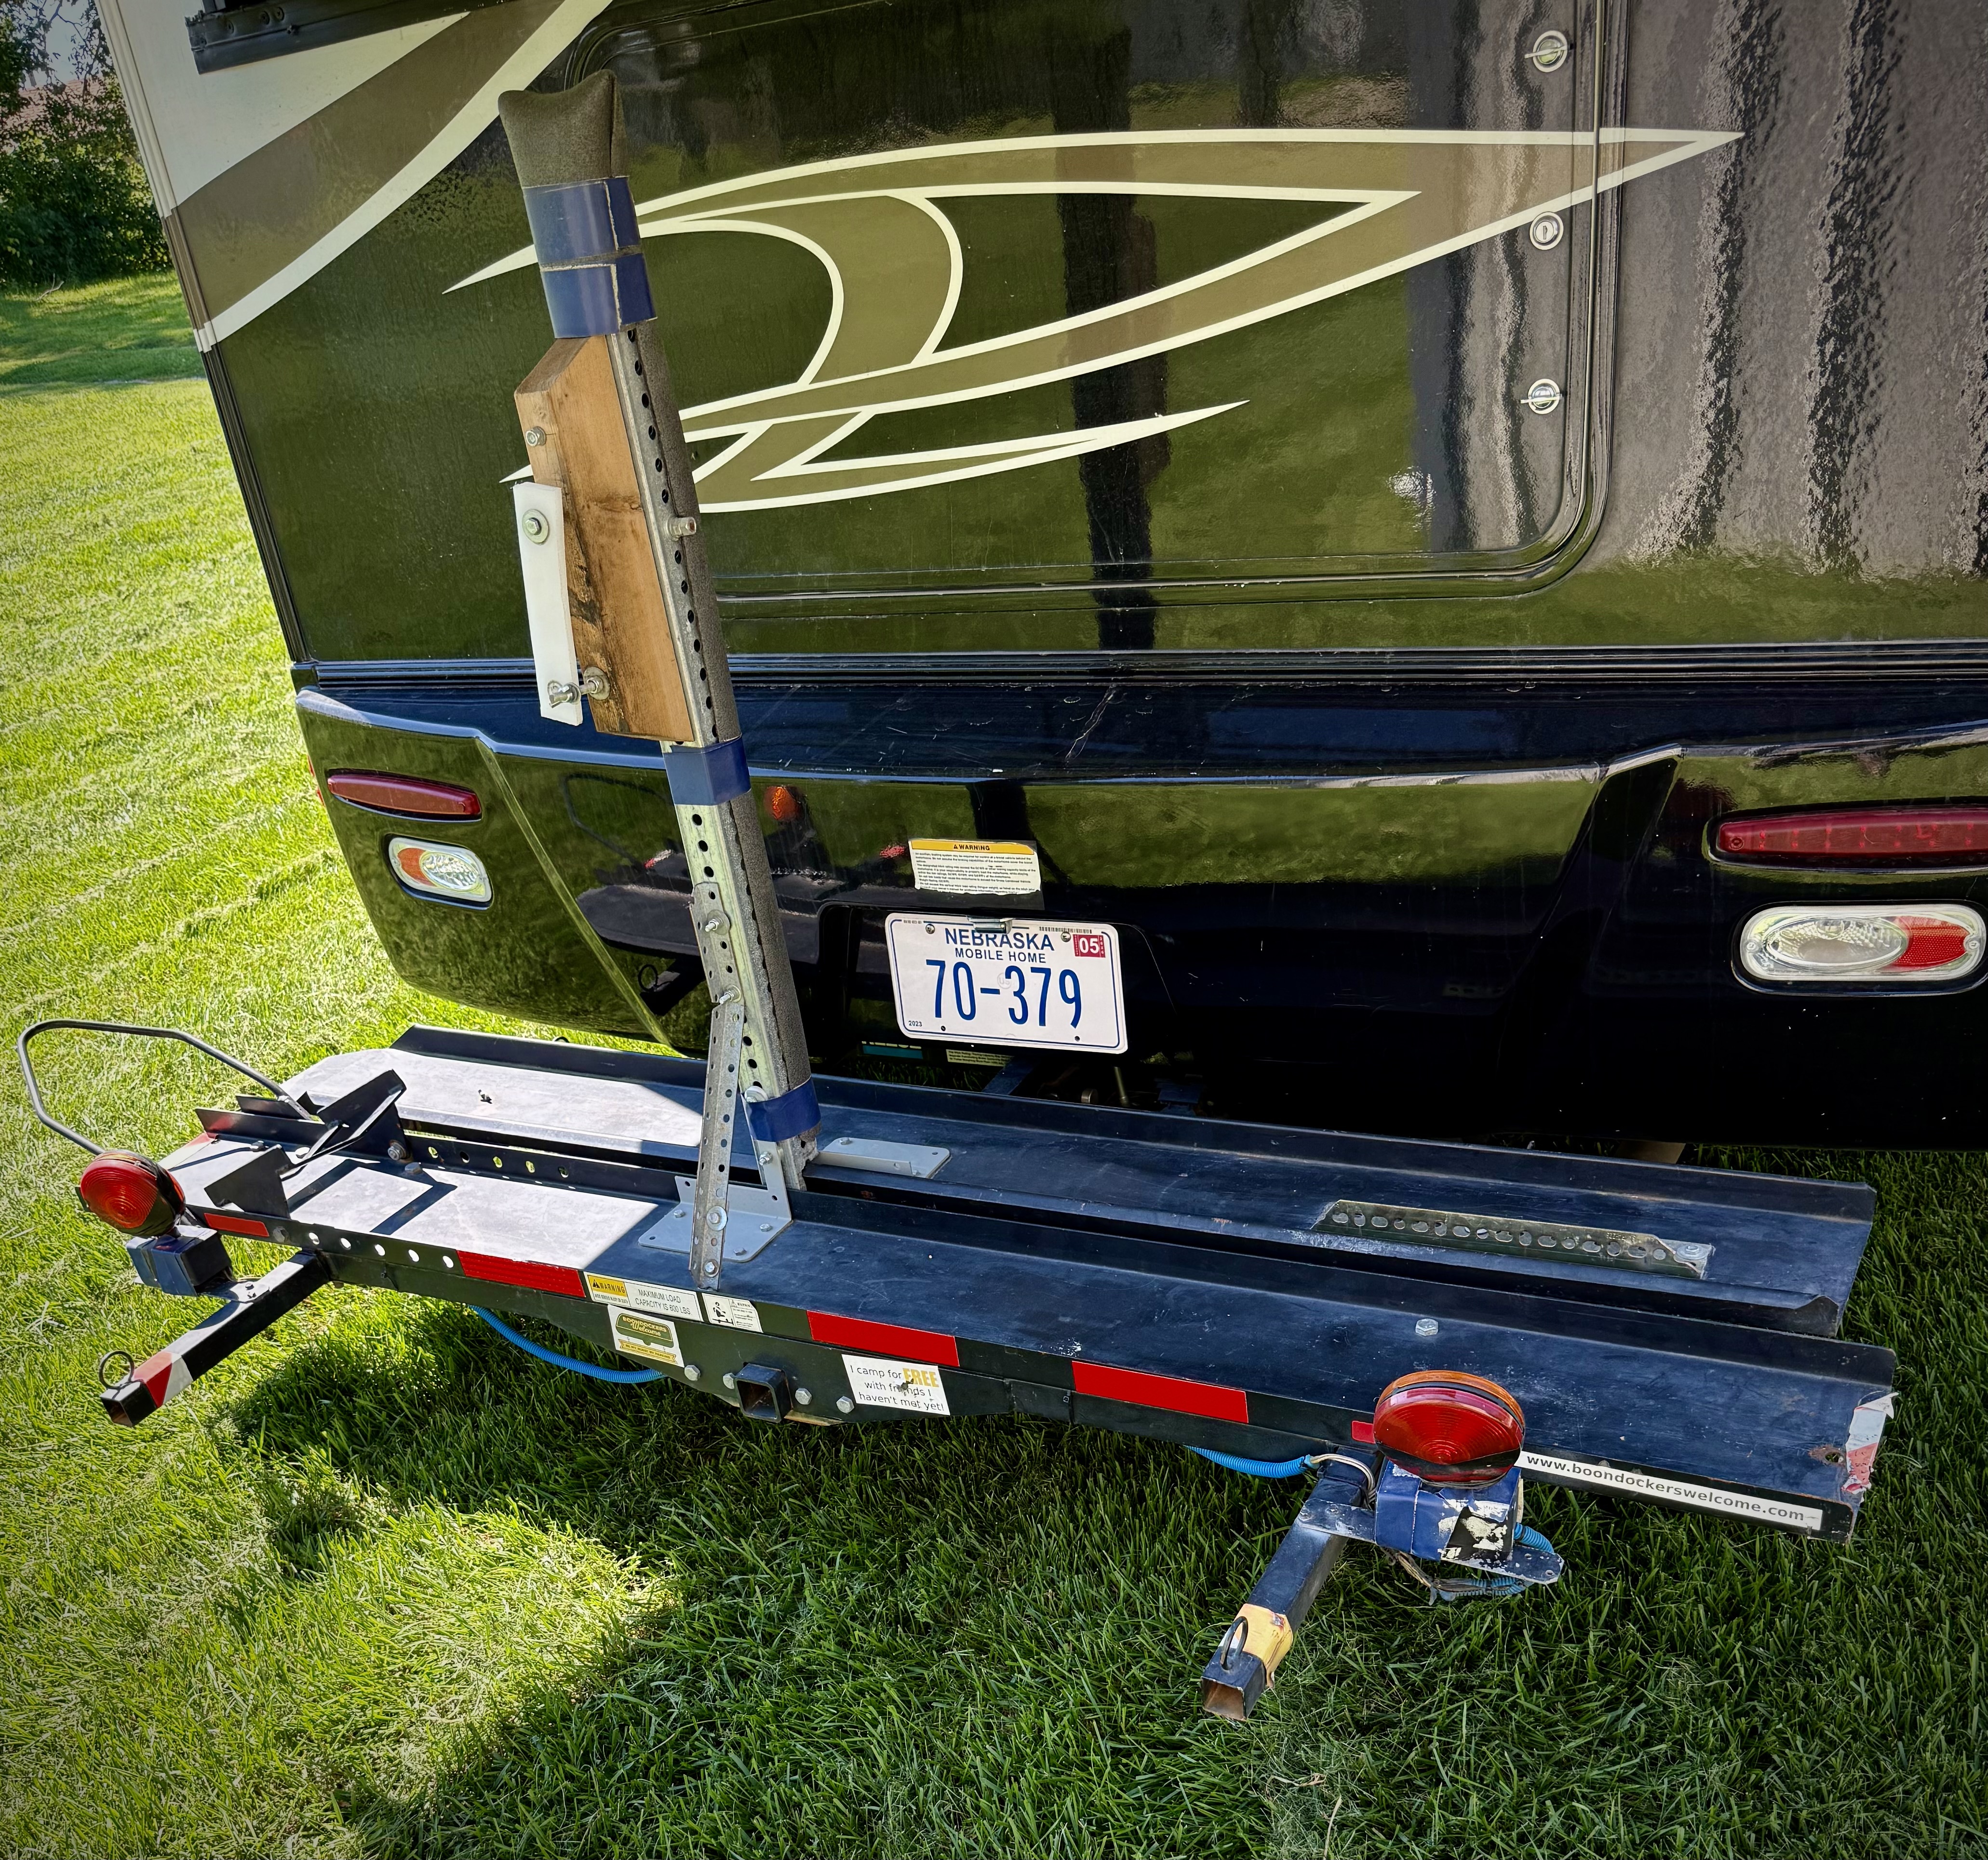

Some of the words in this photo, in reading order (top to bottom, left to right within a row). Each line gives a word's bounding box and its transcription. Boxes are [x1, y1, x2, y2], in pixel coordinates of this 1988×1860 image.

[945, 928, 1055, 951] NEBRASKA
[1079, 937, 1099, 954] 05
[955, 948, 1004, 960] MOBILE
[1008, 951, 1046, 963] HOME
[926, 959, 1082, 1029] 70-379
[599, 1283, 625, 1294] WARNING
[638, 1289, 665, 1300] MAXIMUM
[635, 1298, 662, 1309] CAPACITY
[631, 1322, 661, 1336] Welcome
[857, 1367, 885, 1378] camp
[887, 1369, 902, 1378] for
[902, 1368, 940, 1388] FREE
[864, 1381, 886, 1391] with
[889, 1383, 925, 1396] frnds
[859, 1392, 898, 1405] haven't
[900, 1399, 922, 1408] met
[924, 1402, 944, 1411] yet!
[1527, 1456, 1804, 1521] www.boondockerswelcome.com
